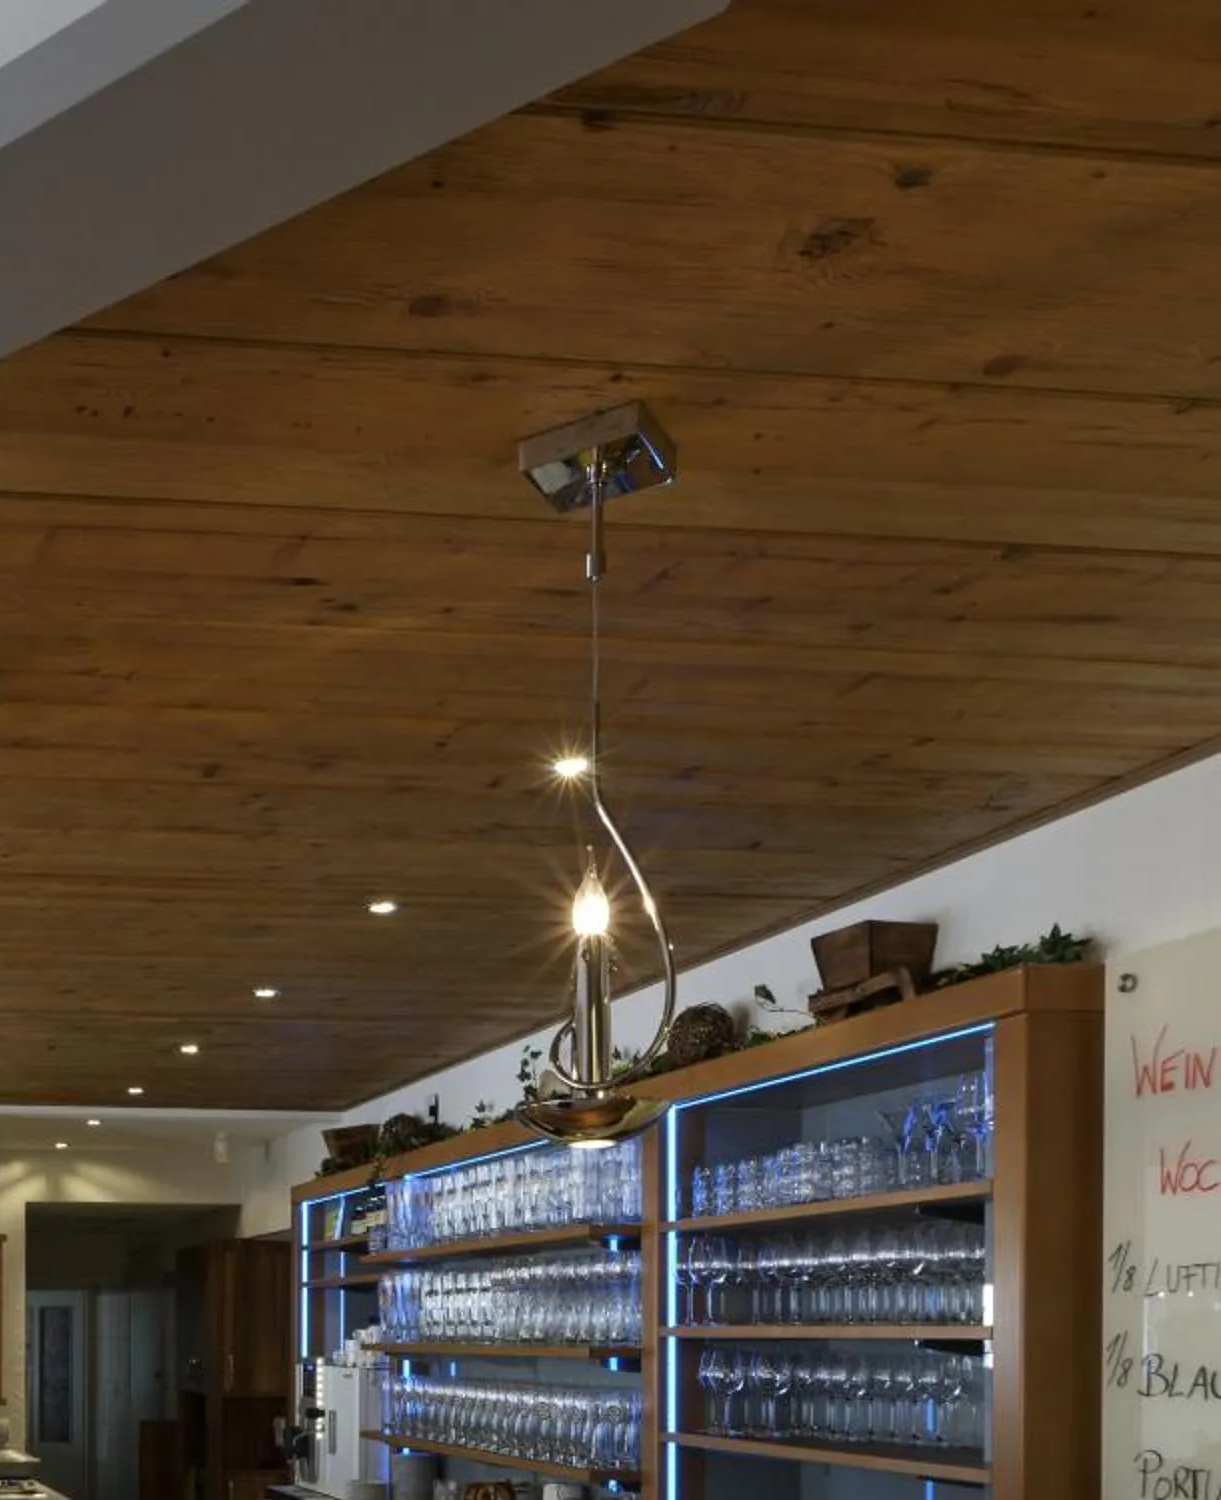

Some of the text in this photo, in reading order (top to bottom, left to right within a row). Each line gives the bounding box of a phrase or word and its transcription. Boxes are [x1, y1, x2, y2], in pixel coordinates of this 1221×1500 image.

[1130, 1023, 1217, 1097] WEIN
[1158, 1138, 1221, 1195] WOC
[1107, 1240, 1137, 1293] 1/8
